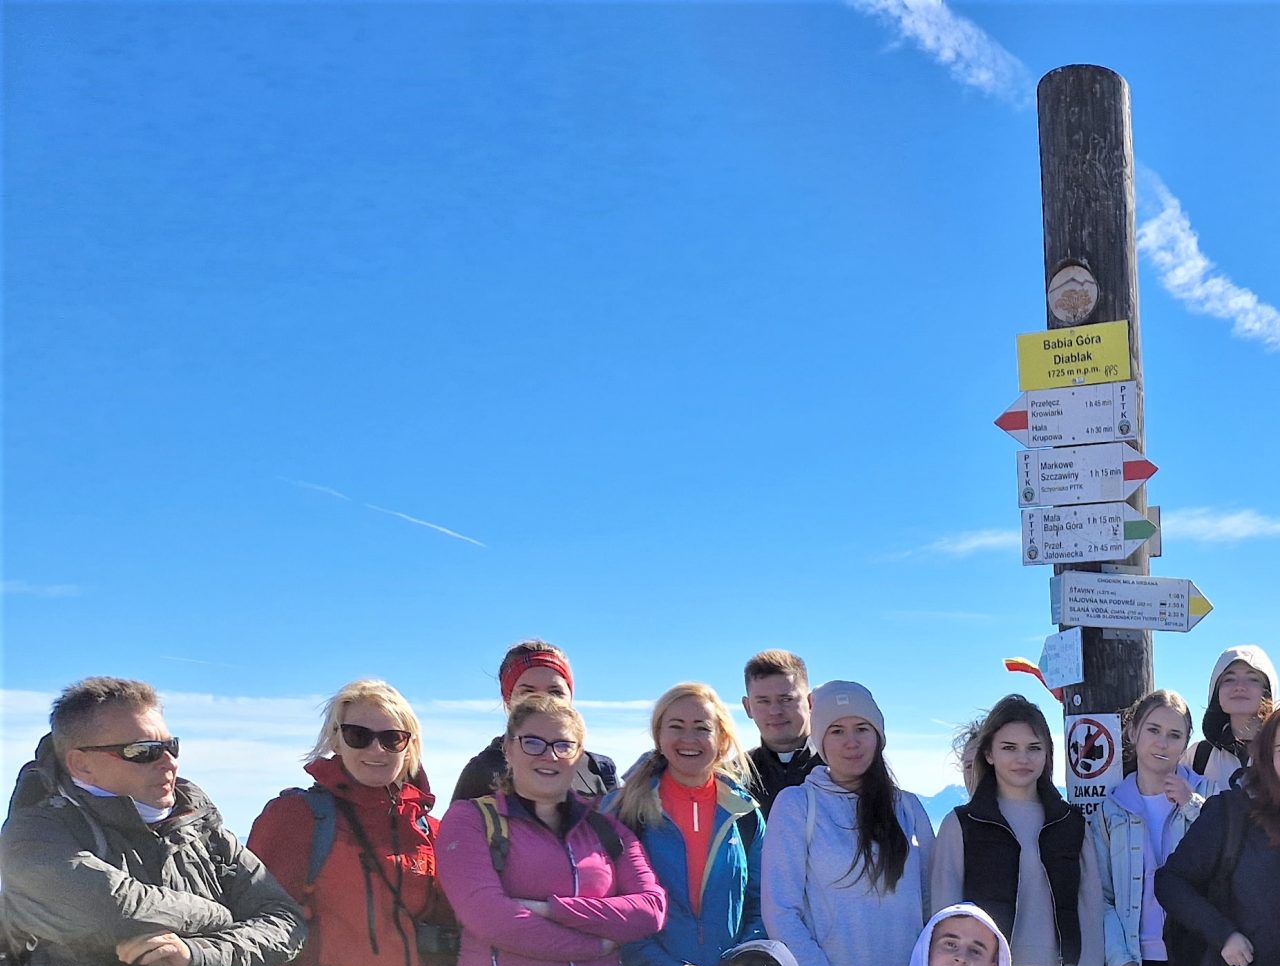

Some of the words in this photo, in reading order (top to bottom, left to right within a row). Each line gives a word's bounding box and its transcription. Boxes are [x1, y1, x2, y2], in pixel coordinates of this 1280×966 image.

[1043, 338, 1073, 351] Babia
[1075, 334, 1102, 347] Góra
[1053, 351, 1093, 365] Diablak
[1047, 368, 1065, 378] 1725
[1076, 366, 1100, 376] n.p.m.
[1030, 399, 1061, 408] Przełęcz
[1031, 409, 1063, 418] Krowiarki
[1032, 433, 1063, 442] Krupowa
[1040, 461, 1074, 470] Markowe
[1040, 471, 1079, 482] Szczawiny
[1094, 469, 1100, 477] h
[1101, 468, 1109, 477] 15
[1109, 467, 1121, 476] min
[1108, 515, 1121, 523] min
[1066, 521, 1083, 530] Góra
[1093, 544, 1099, 552] h
[1110, 543, 1122, 551] min
[1044, 550, 1083, 560] Jałowiecka
[1074, 785, 1106, 797] ZAKAZ
